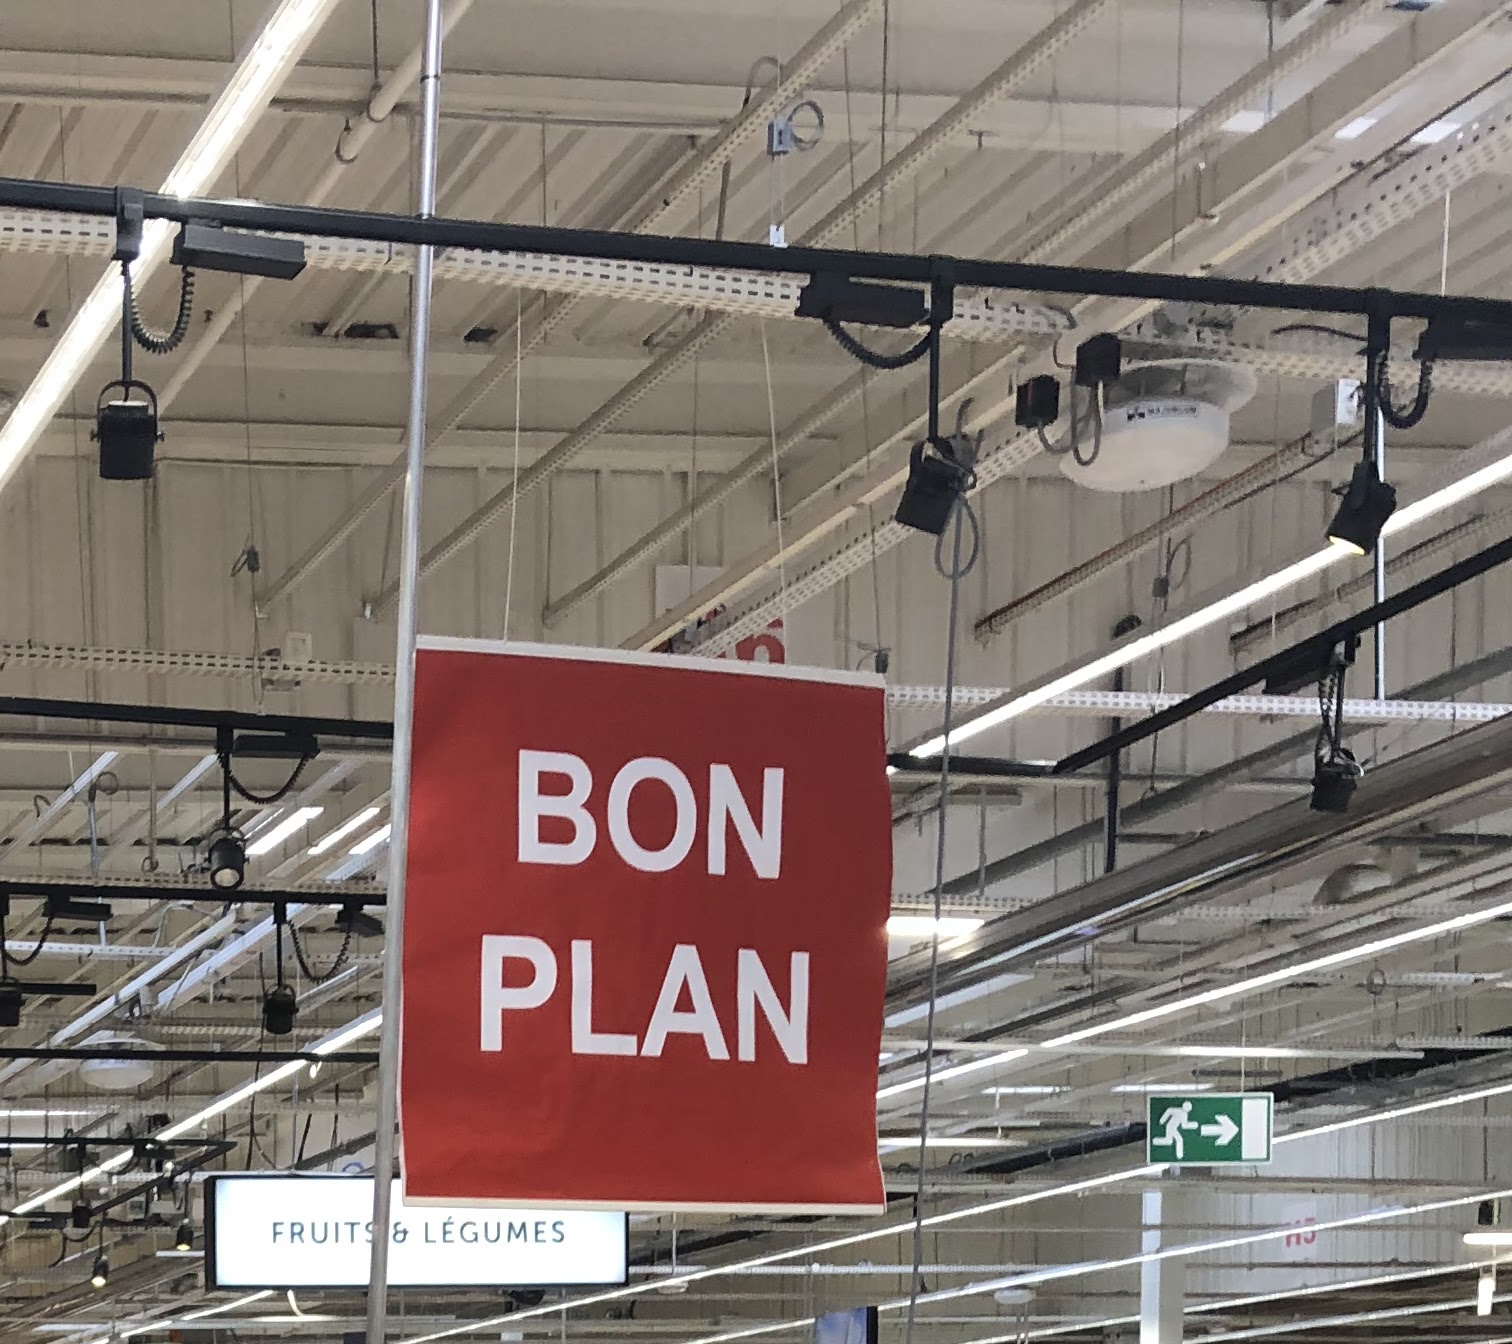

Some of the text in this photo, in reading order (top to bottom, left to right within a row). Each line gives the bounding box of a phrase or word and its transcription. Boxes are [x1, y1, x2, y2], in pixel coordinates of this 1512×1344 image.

[517, 749, 785, 879] BON
[480, 933, 810, 1064] PLAN
[392, 1221, 409, 1243] &
[424, 1216, 566, 1243] LÉGUMES
